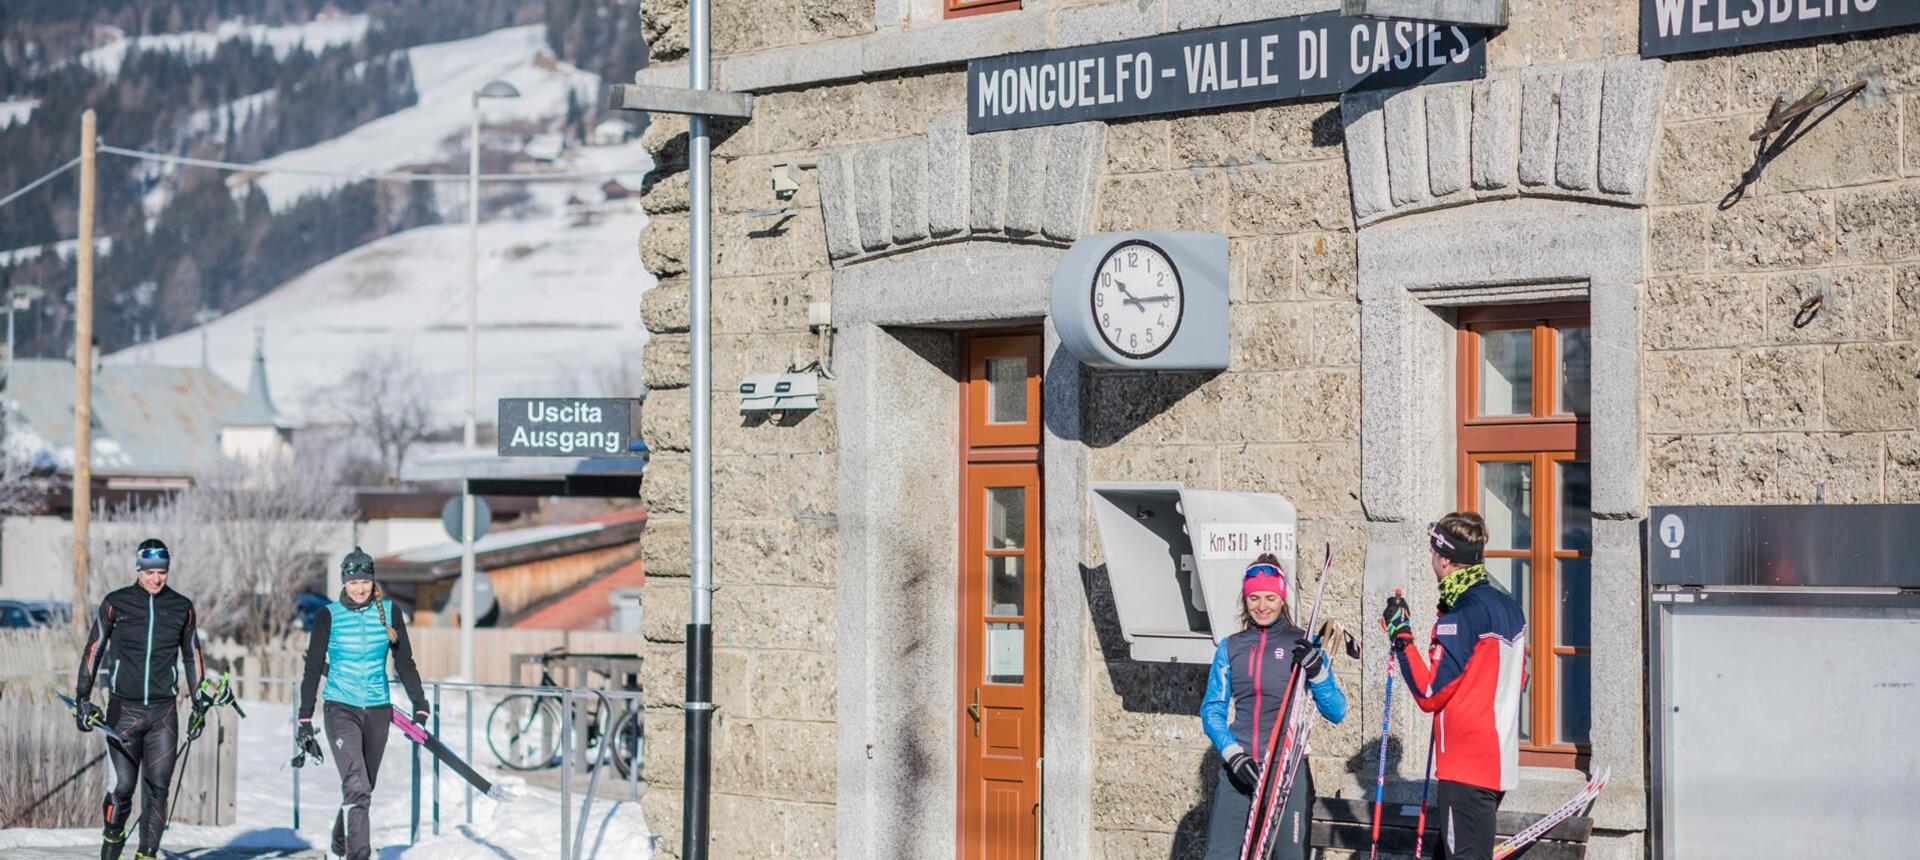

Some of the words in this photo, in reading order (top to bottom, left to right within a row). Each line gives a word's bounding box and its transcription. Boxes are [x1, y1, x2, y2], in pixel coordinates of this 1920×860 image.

[978, 51, 1153, 118] MONGUELFO
[1183, 33, 1279, 95] VALLE
[1298, 27, 1328, 81] DI
[1350, 21, 1470, 75] CASIES
[1113, 257, 1122, 273] 11
[1128, 252, 1138, 268] 12
[1146, 258, 1151, 273] 1
[1101, 272, 1112, 288] 10
[1156, 272, 1164, 287] 2
[1096, 293, 1104, 308] 9
[1102, 313, 1110, 328] 8
[1157, 313, 1165, 328] 4
[1115, 328, 1122, 343] 7
[1130, 333, 1138, 349] 6
[1146, 328, 1153, 343] 5
[527, 401, 603, 423] Uscita
[510, 426, 620, 453] Ausgang
